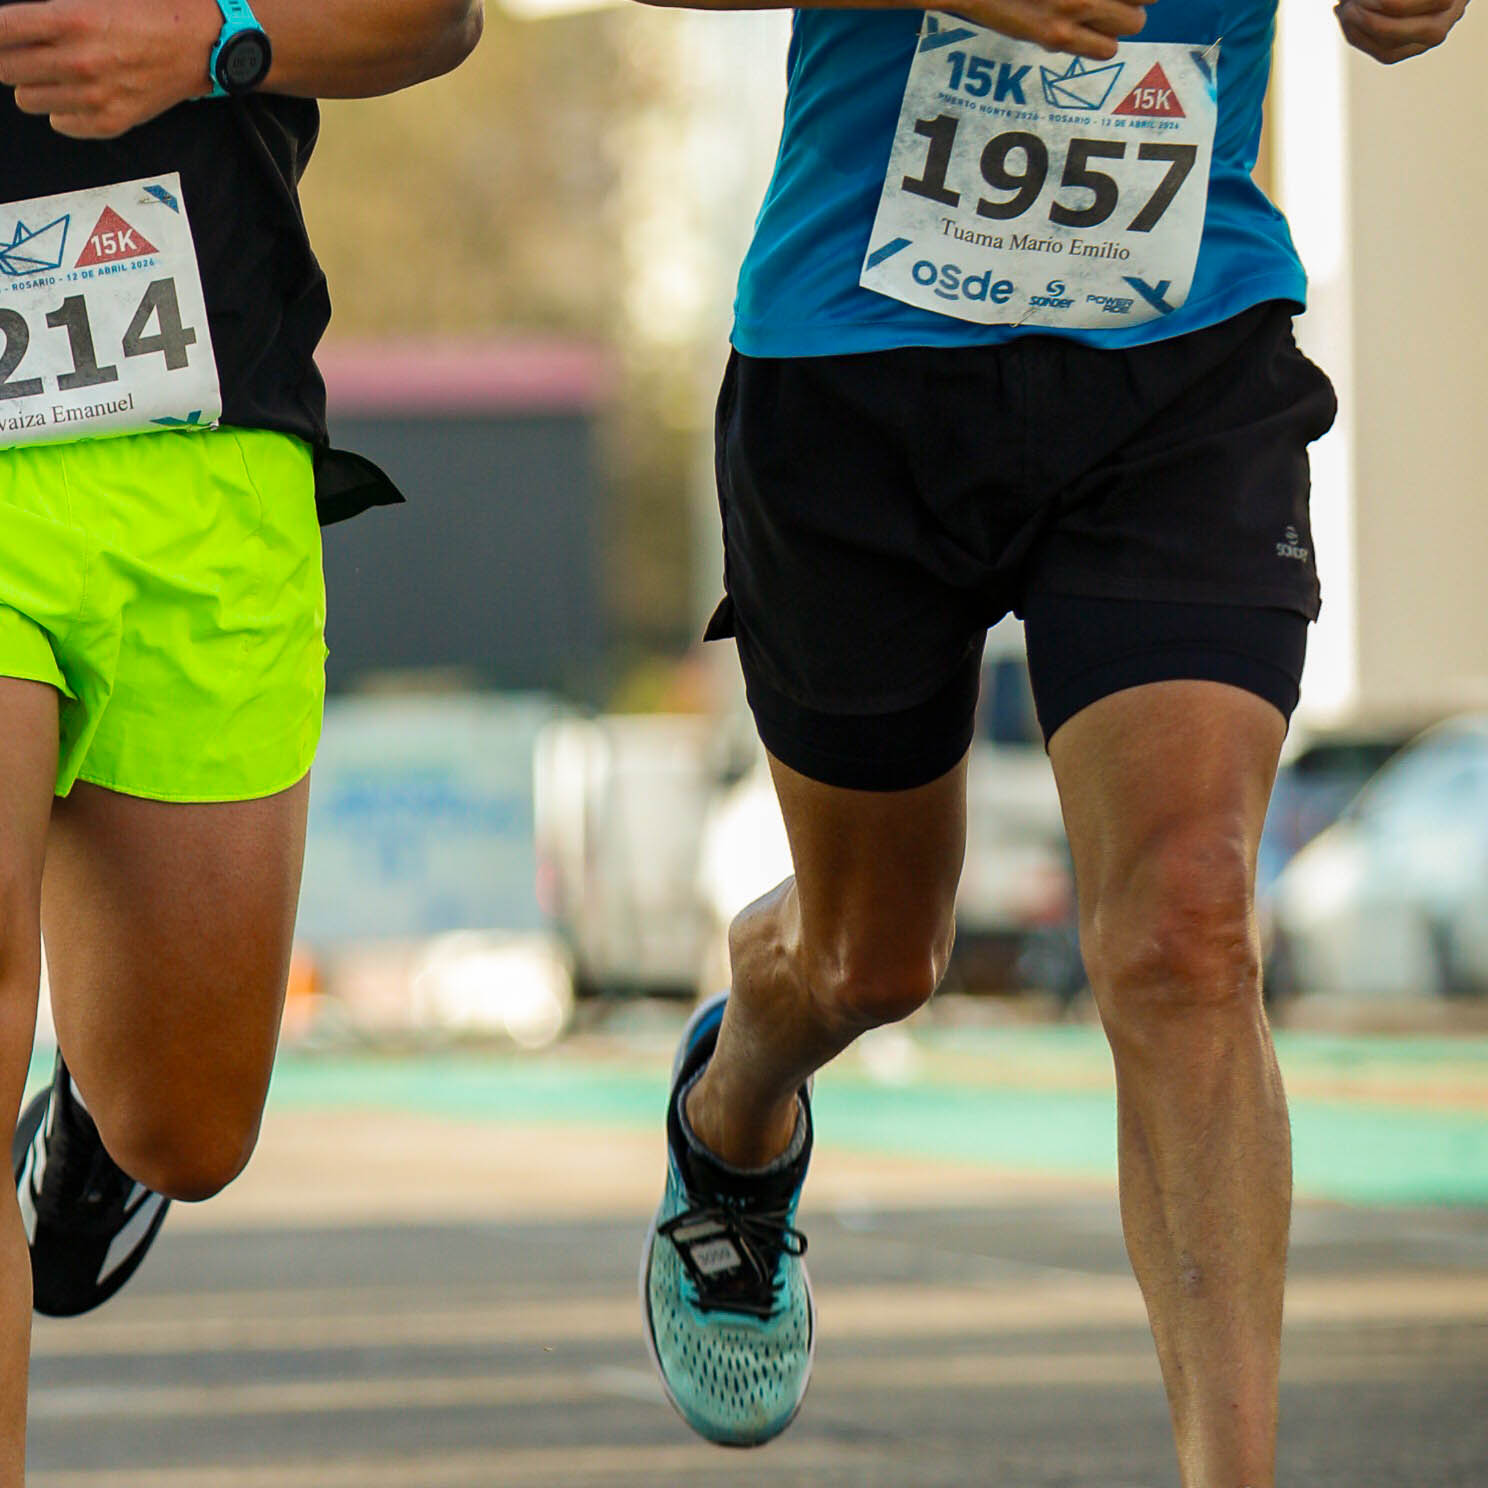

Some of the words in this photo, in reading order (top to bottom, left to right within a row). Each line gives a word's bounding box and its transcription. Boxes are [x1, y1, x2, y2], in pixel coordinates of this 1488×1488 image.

[947, 50, 1033, 105] 15K
[1132, 86, 1171, 111] 15K
[1048, 113, 1091, 125] ROSARIO
[1129, 120, 1154, 128] ABRIL
[901, 114, 1198, 233] 1957
[90, 228, 140, 257] 15K
[939, 217, 1003, 250] Tuama
[1010, 233, 1063, 254] Mario
[1068, 239, 1131, 261] Emilio
[12, 277, 55, 291] ROSARIO
[66, 272, 78, 281] 12
[81, 270, 94, 279] DE
[98, 264, 127, 276] ABRIL
[131, 258, 154, 269] 2026
[911, 259, 1014, 304] osde
[52, 393, 134, 424] Emanuel
